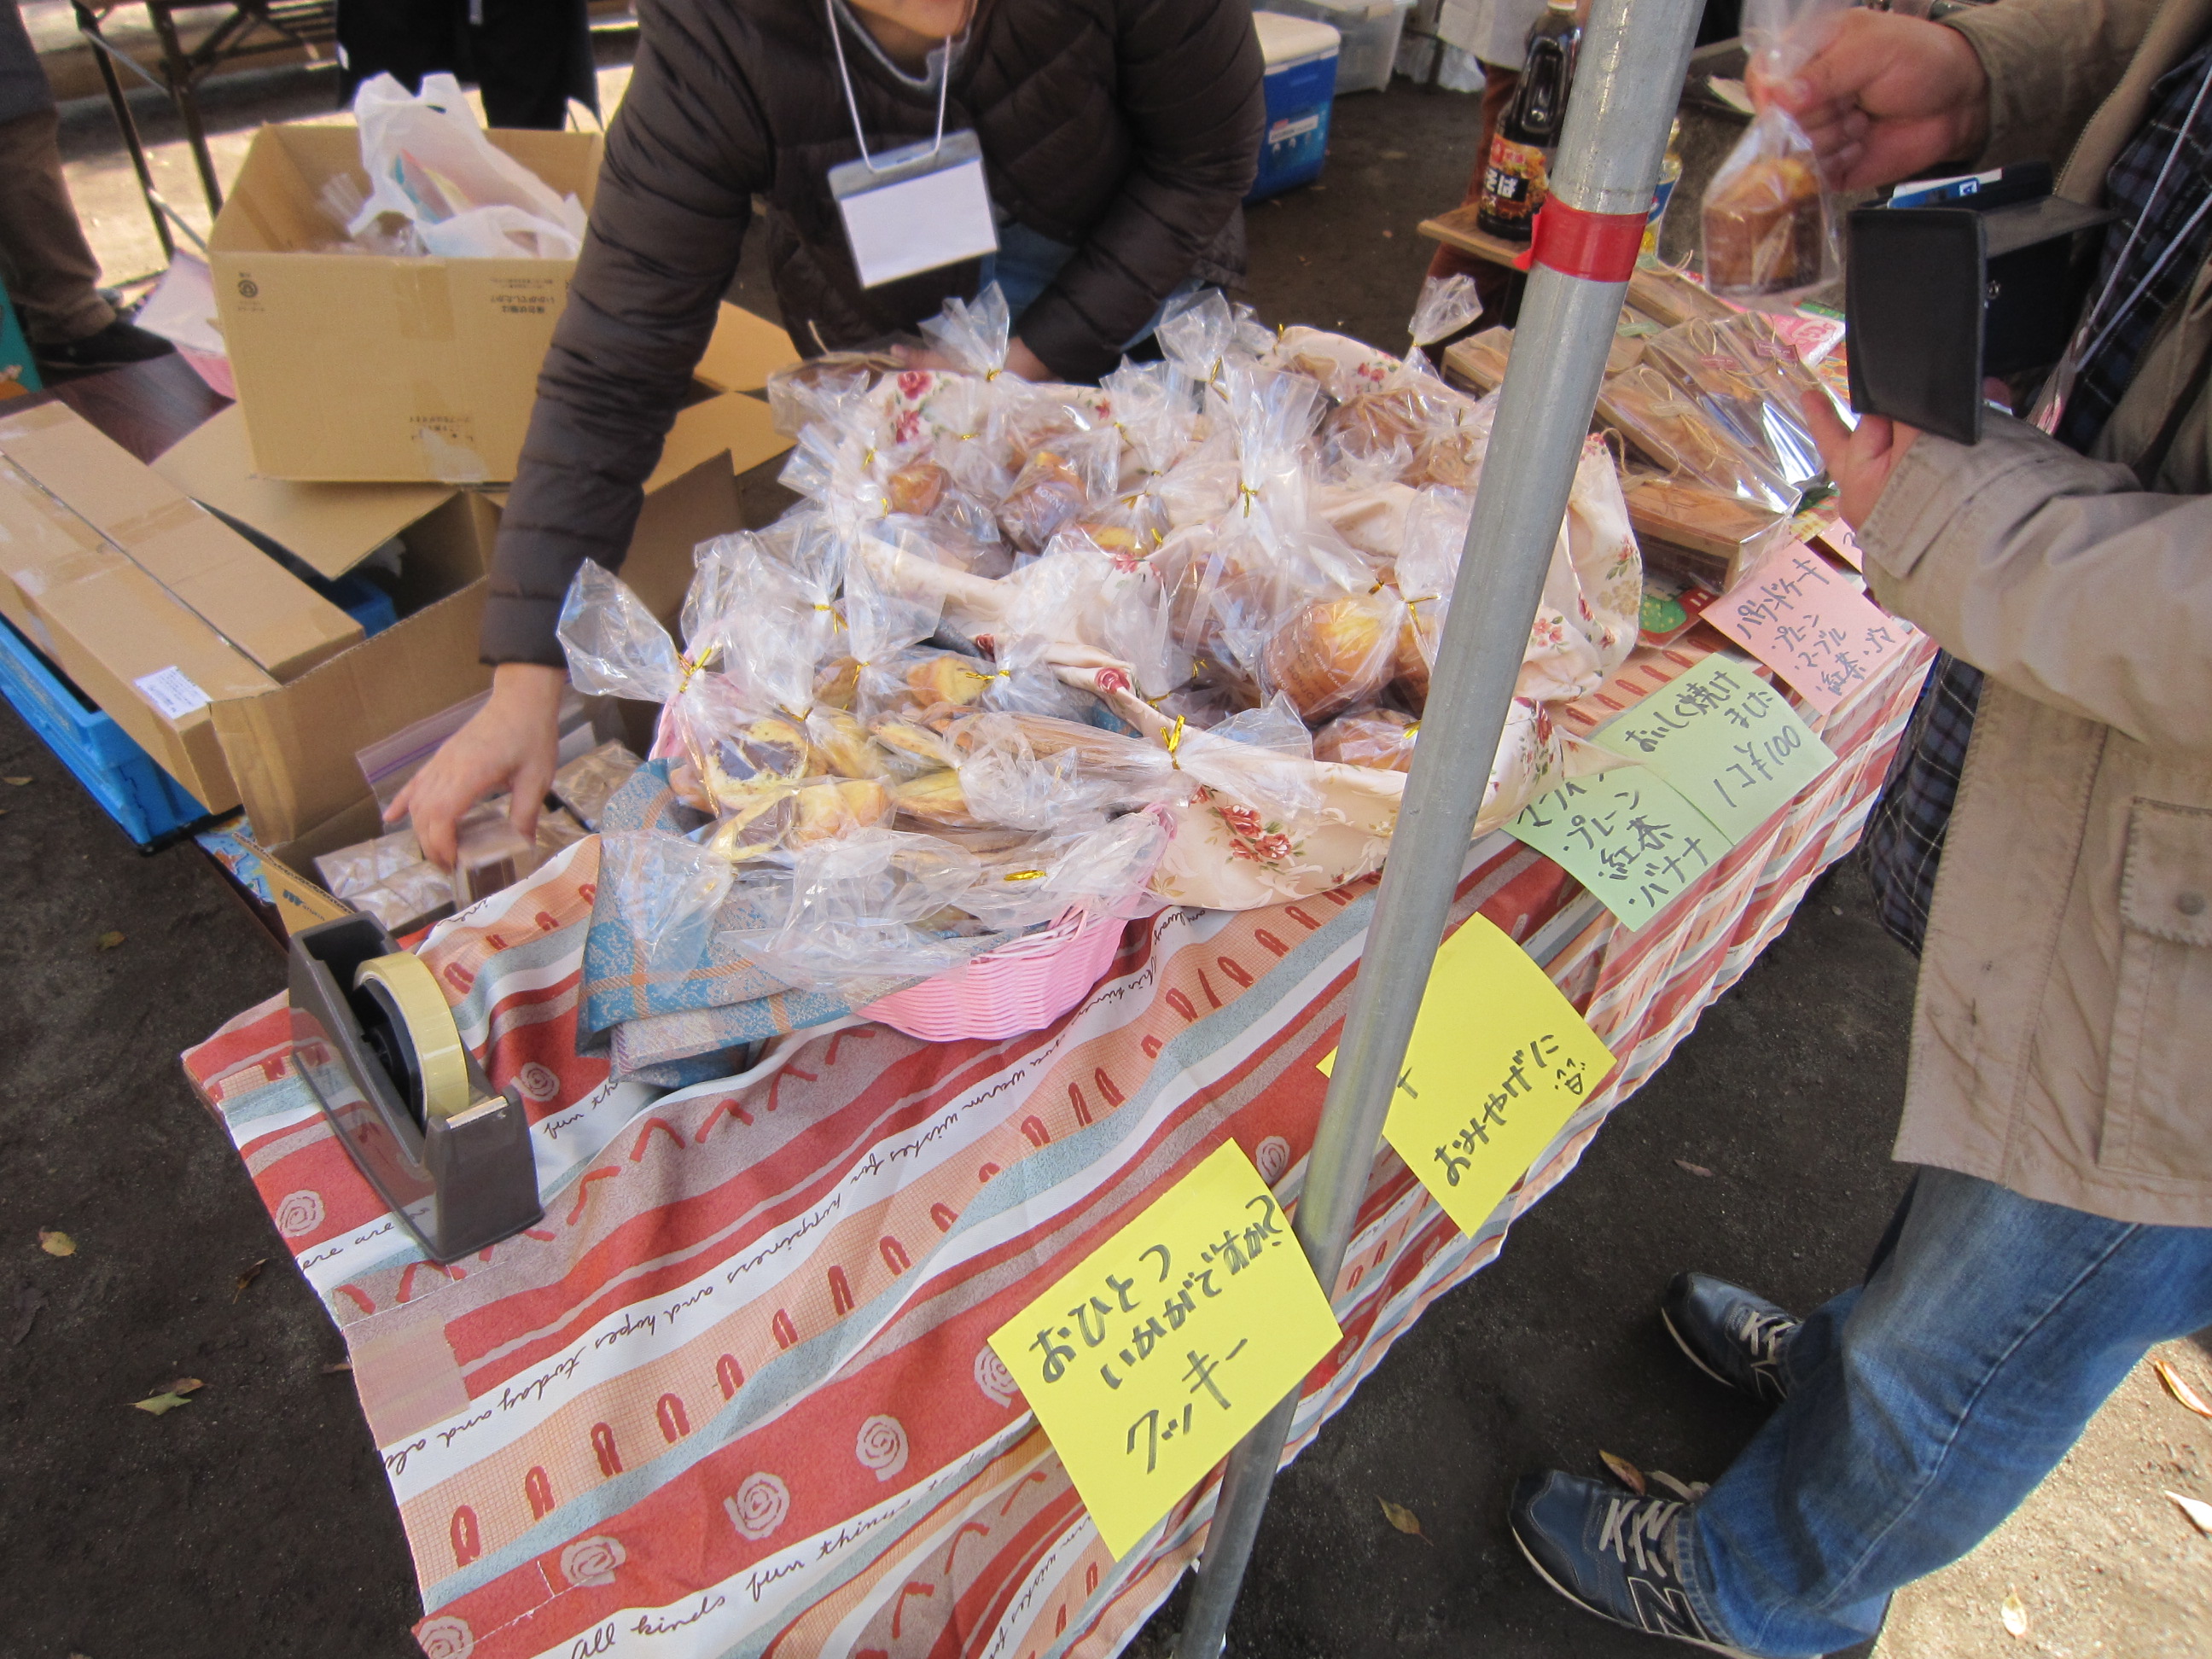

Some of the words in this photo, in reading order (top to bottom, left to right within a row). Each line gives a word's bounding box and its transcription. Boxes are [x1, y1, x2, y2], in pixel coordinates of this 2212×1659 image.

[1625, 671, 1741, 753] おいしく焼け
[1724, 691, 1774, 729] ました
[962, 1069, 1026, 1111] warm
[1434, 1034, 1560, 1187] おみやげに
[543, 1113, 585, 1140] fun
[889, 1113, 958, 1161] wishes
[849, 1152, 885, 1185] for
[354, 1221, 395, 1245] are
[663, 1285, 713, 1324] and
[1029, 1243, 1172, 1383] おひとつ
[594, 1313, 656, 1350] hopes
[497, 1345, 587, 1412] today
[1126, 1337, 1248, 1475] クッキー
[436, 1409, 492, 1448] and
[630, 1594, 726, 1636] kinds
[745, 1559, 806, 1603] fun
